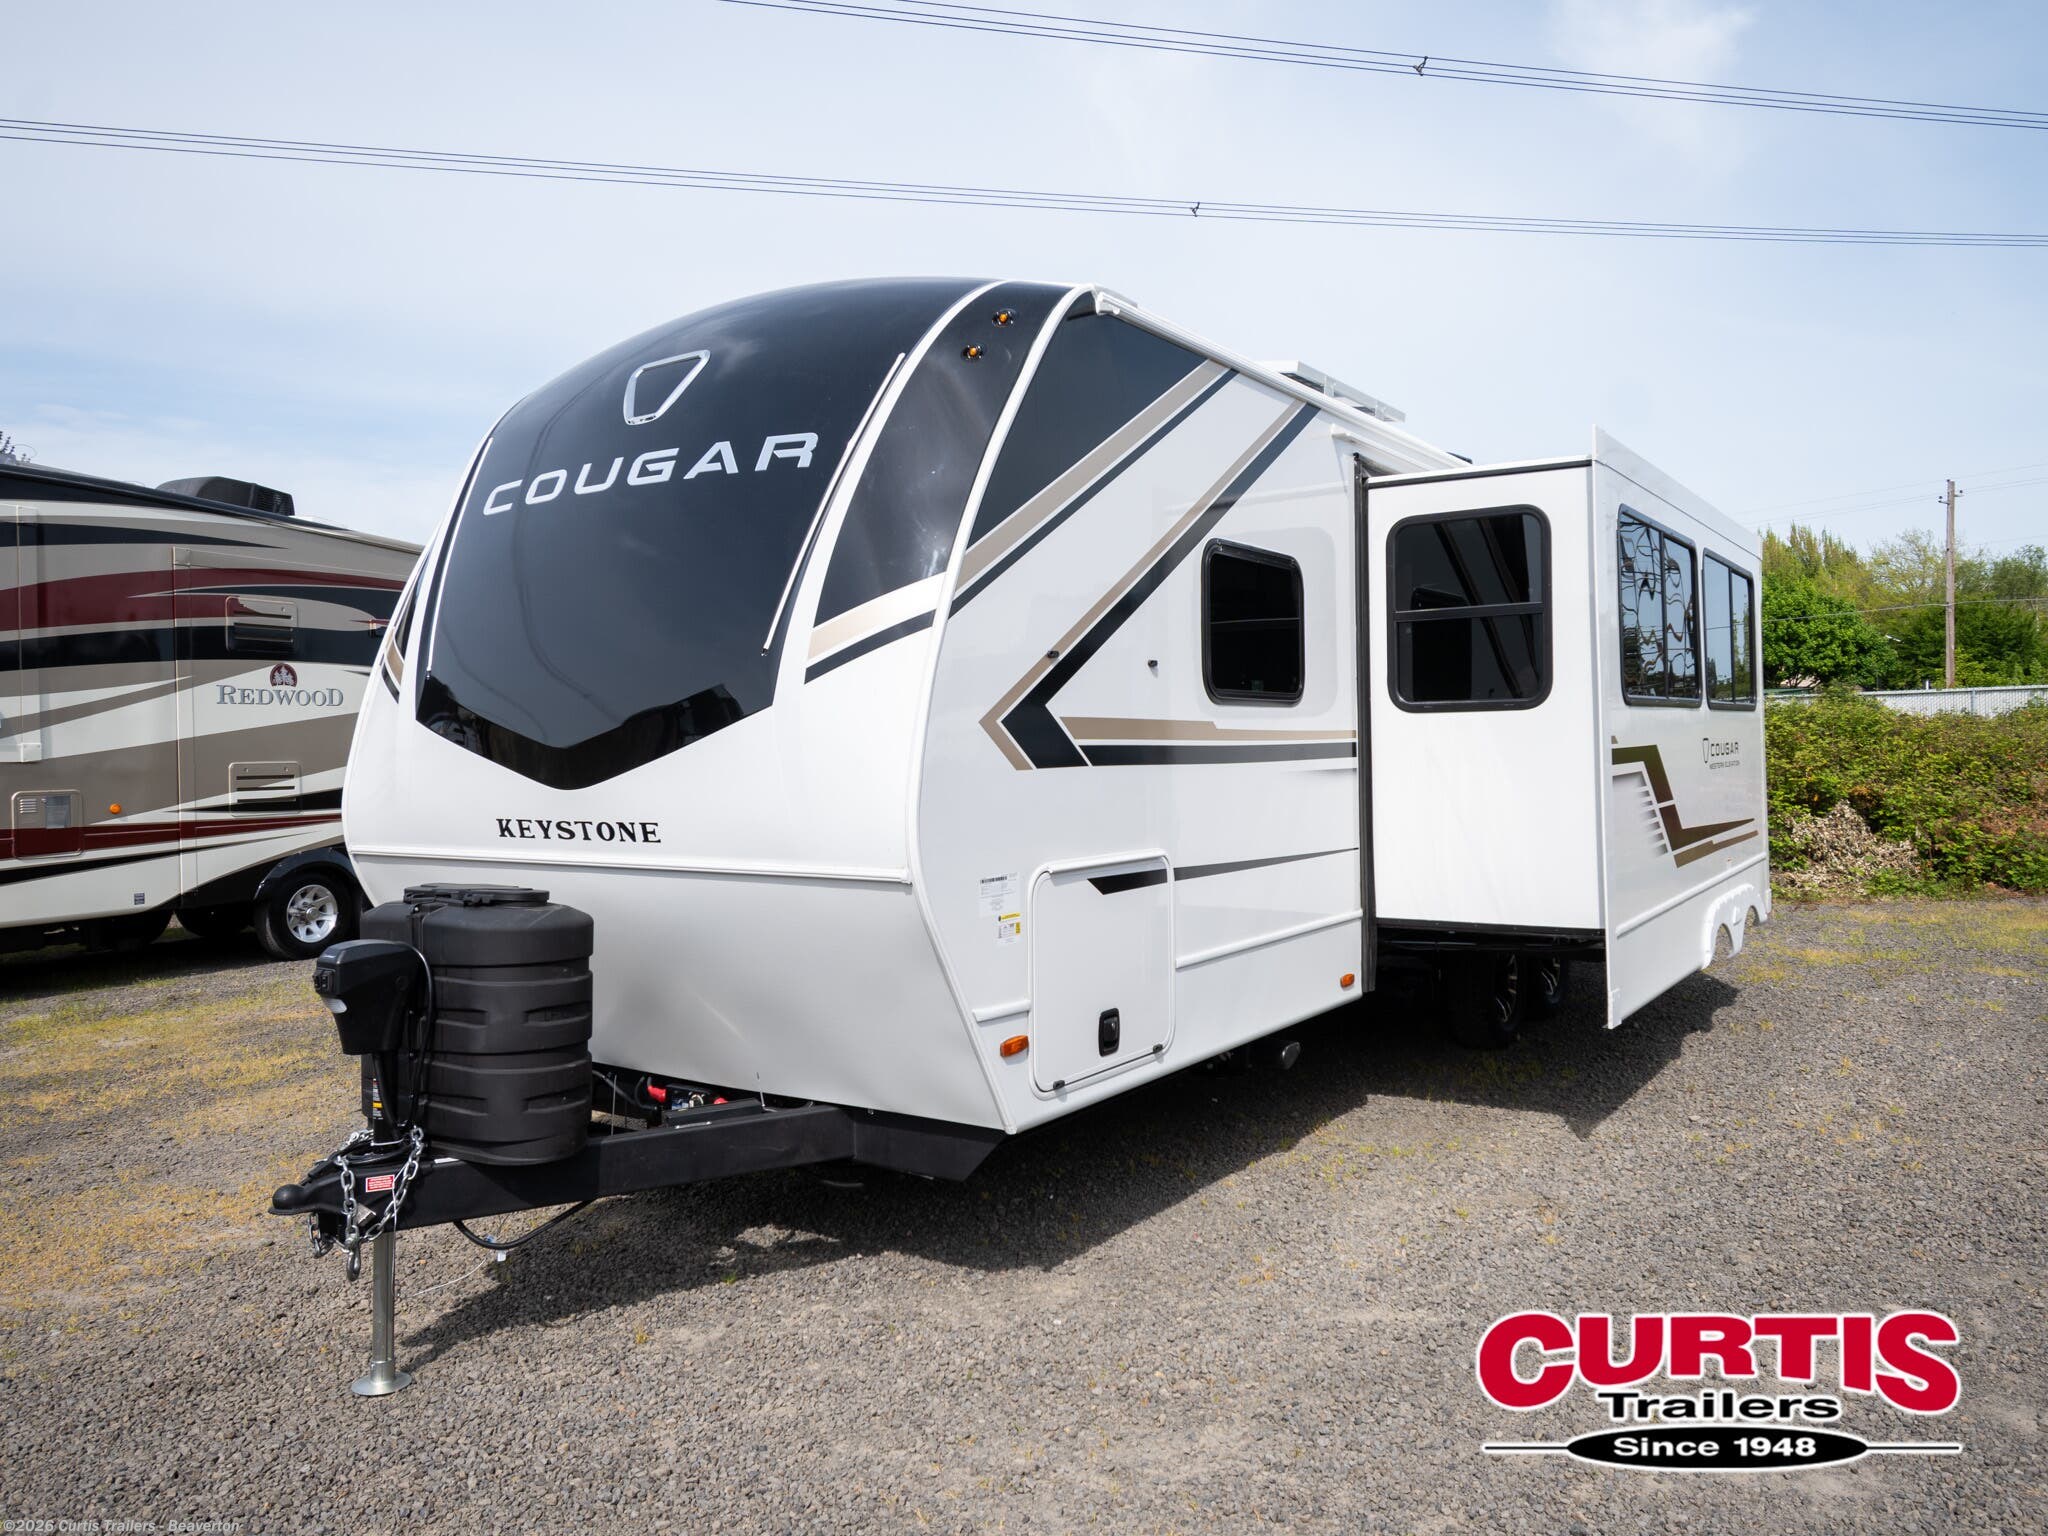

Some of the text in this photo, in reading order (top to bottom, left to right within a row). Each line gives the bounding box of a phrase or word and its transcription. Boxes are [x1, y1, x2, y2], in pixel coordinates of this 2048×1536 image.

[483, 432, 819, 516] COUGAR
[216, 684, 344, 706] REDWOOD
[1711, 742, 1739, 756] COUGAR
[496, 818, 661, 843] KEYSTONE
